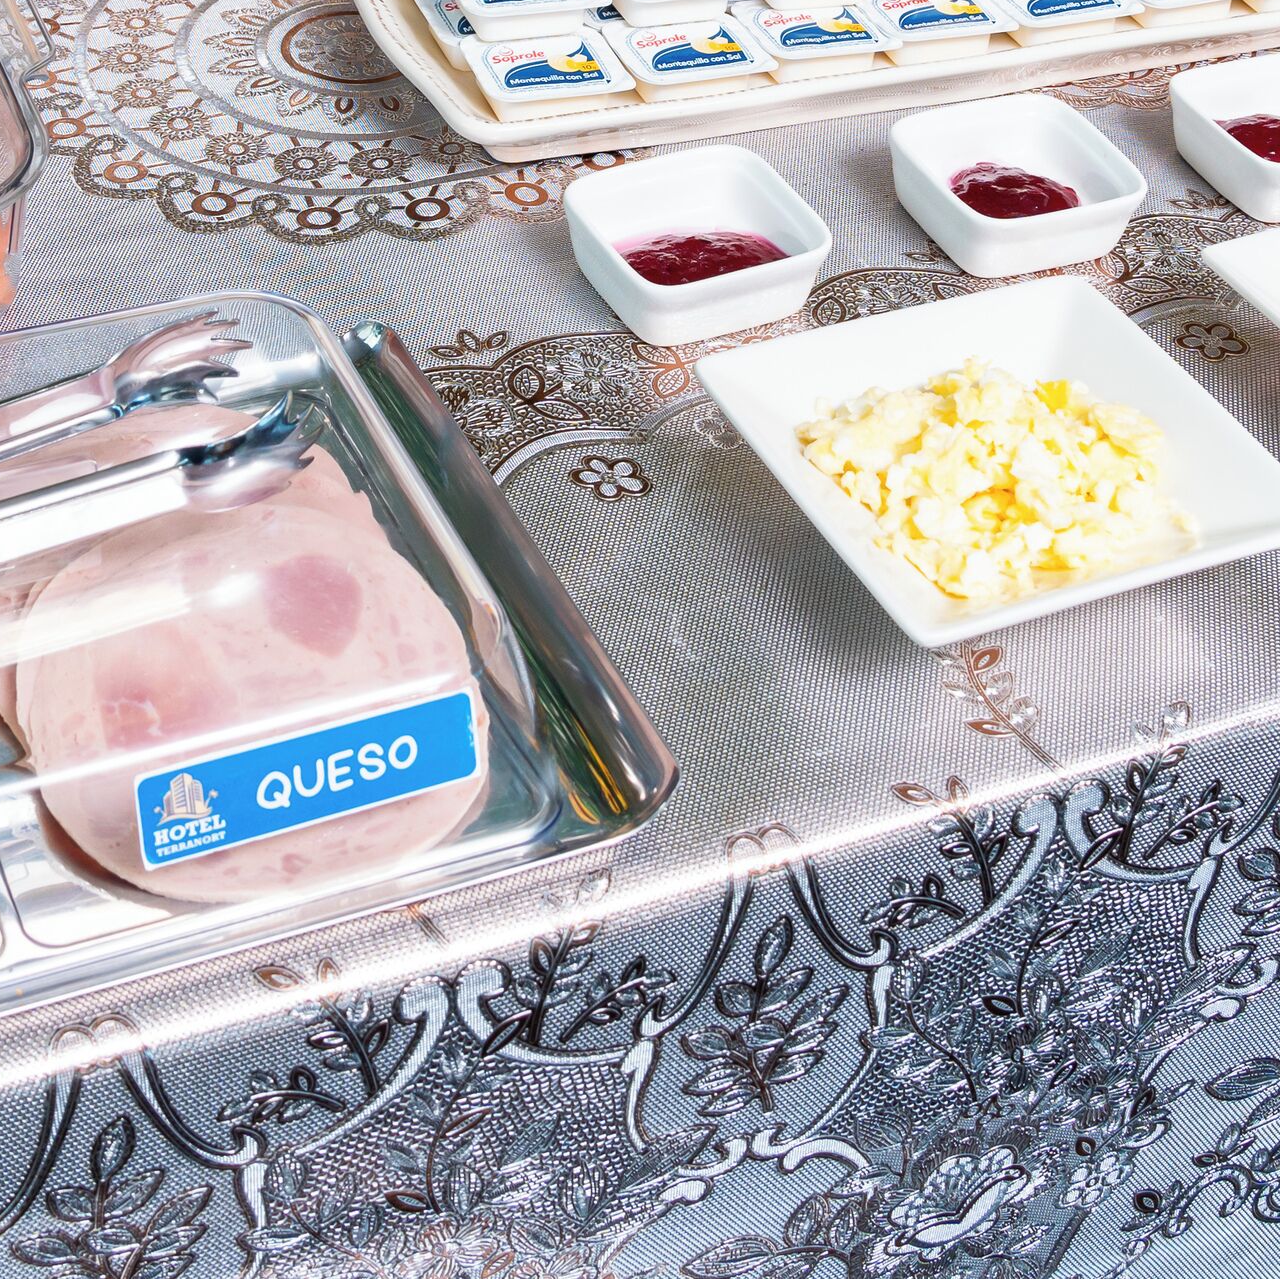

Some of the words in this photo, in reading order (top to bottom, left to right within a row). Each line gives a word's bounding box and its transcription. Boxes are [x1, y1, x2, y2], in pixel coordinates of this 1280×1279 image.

[882, 0, 930, 10] Soprole
[763, 14, 812, 27] Soprole
[636, 34, 687, 48] Soprole
[785, 34, 836, 46] Mantequilla
[492, 51, 545, 64] Soprole
[657, 57, 710, 70] Mantequilla
[510, 74, 565, 85] Mantequilla
[256, 735, 418, 809] QUESO
[153, 814, 226, 846] HOTEL
[156, 830, 226, 857] TERRANORT
